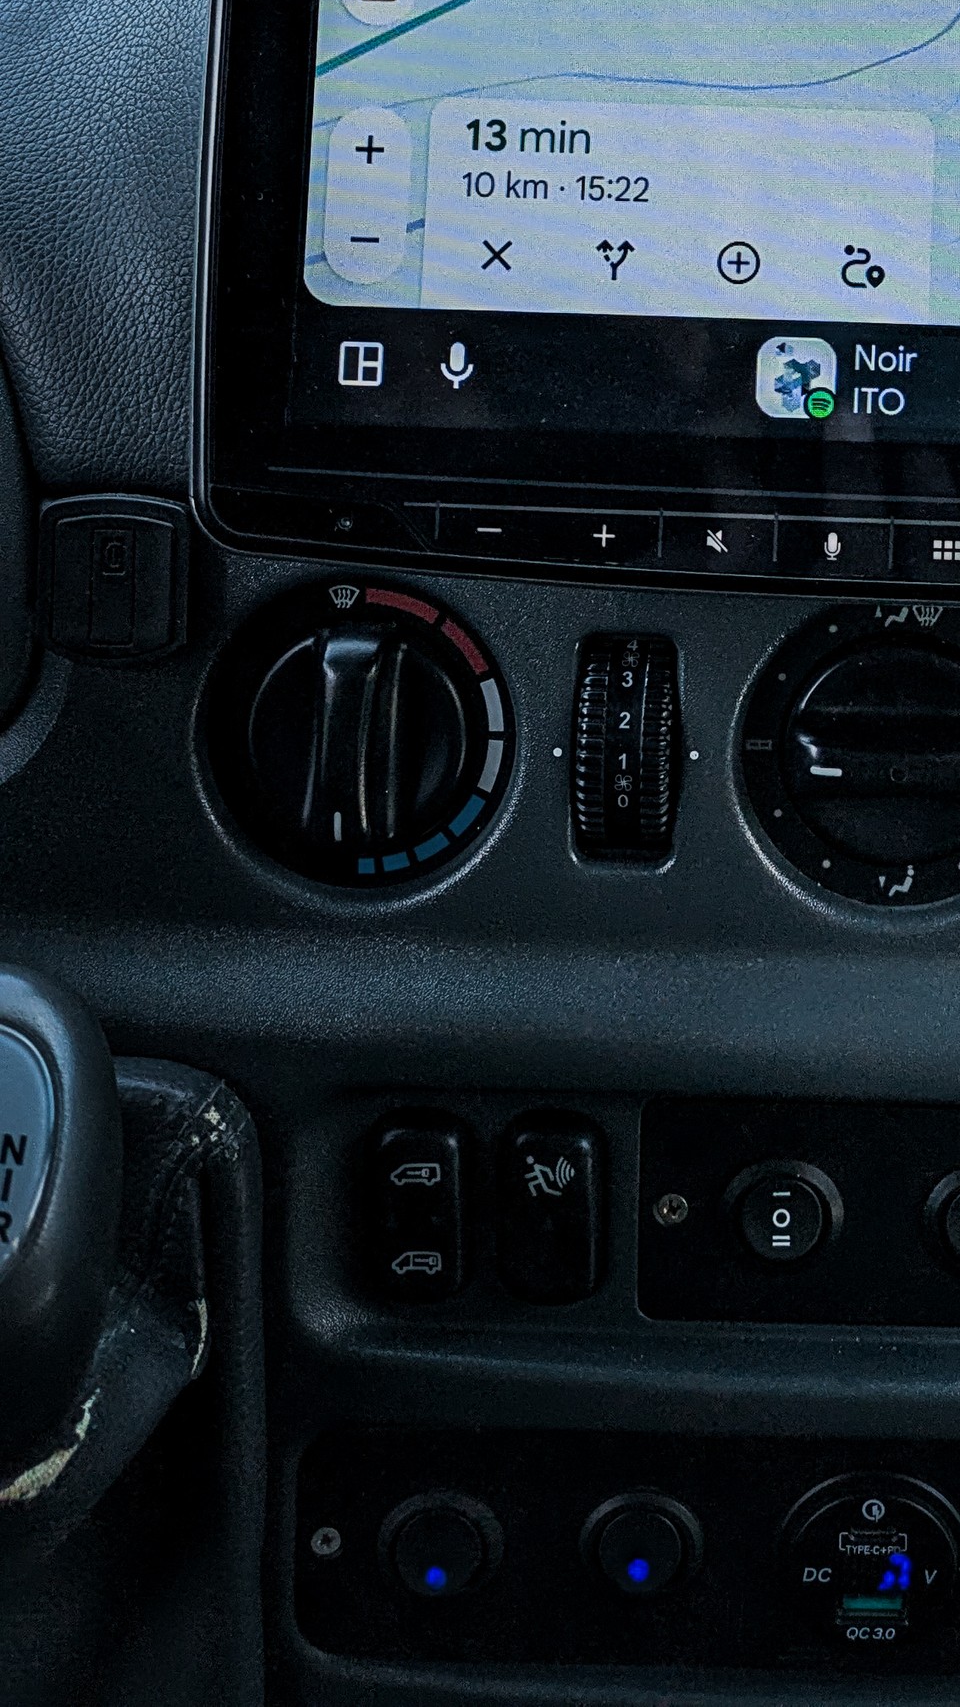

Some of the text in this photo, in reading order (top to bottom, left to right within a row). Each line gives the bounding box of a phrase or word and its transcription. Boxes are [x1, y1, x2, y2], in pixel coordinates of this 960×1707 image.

[466, 119, 592, 155] 13 min
[462, 171, 650, 203] 10 km 15:22
[854, 344, 917, 372] Noir
[853, 387, 906, 415] ITO
[622, 671, 633, 688] 3
[619, 712, 630, 729] 2
[618, 753, 626, 770] 1
[803, 1568, 832, 1582] DC
[924, 1569, 938, 1585] V
[846, 1627, 896, 1641] QC 3.0
